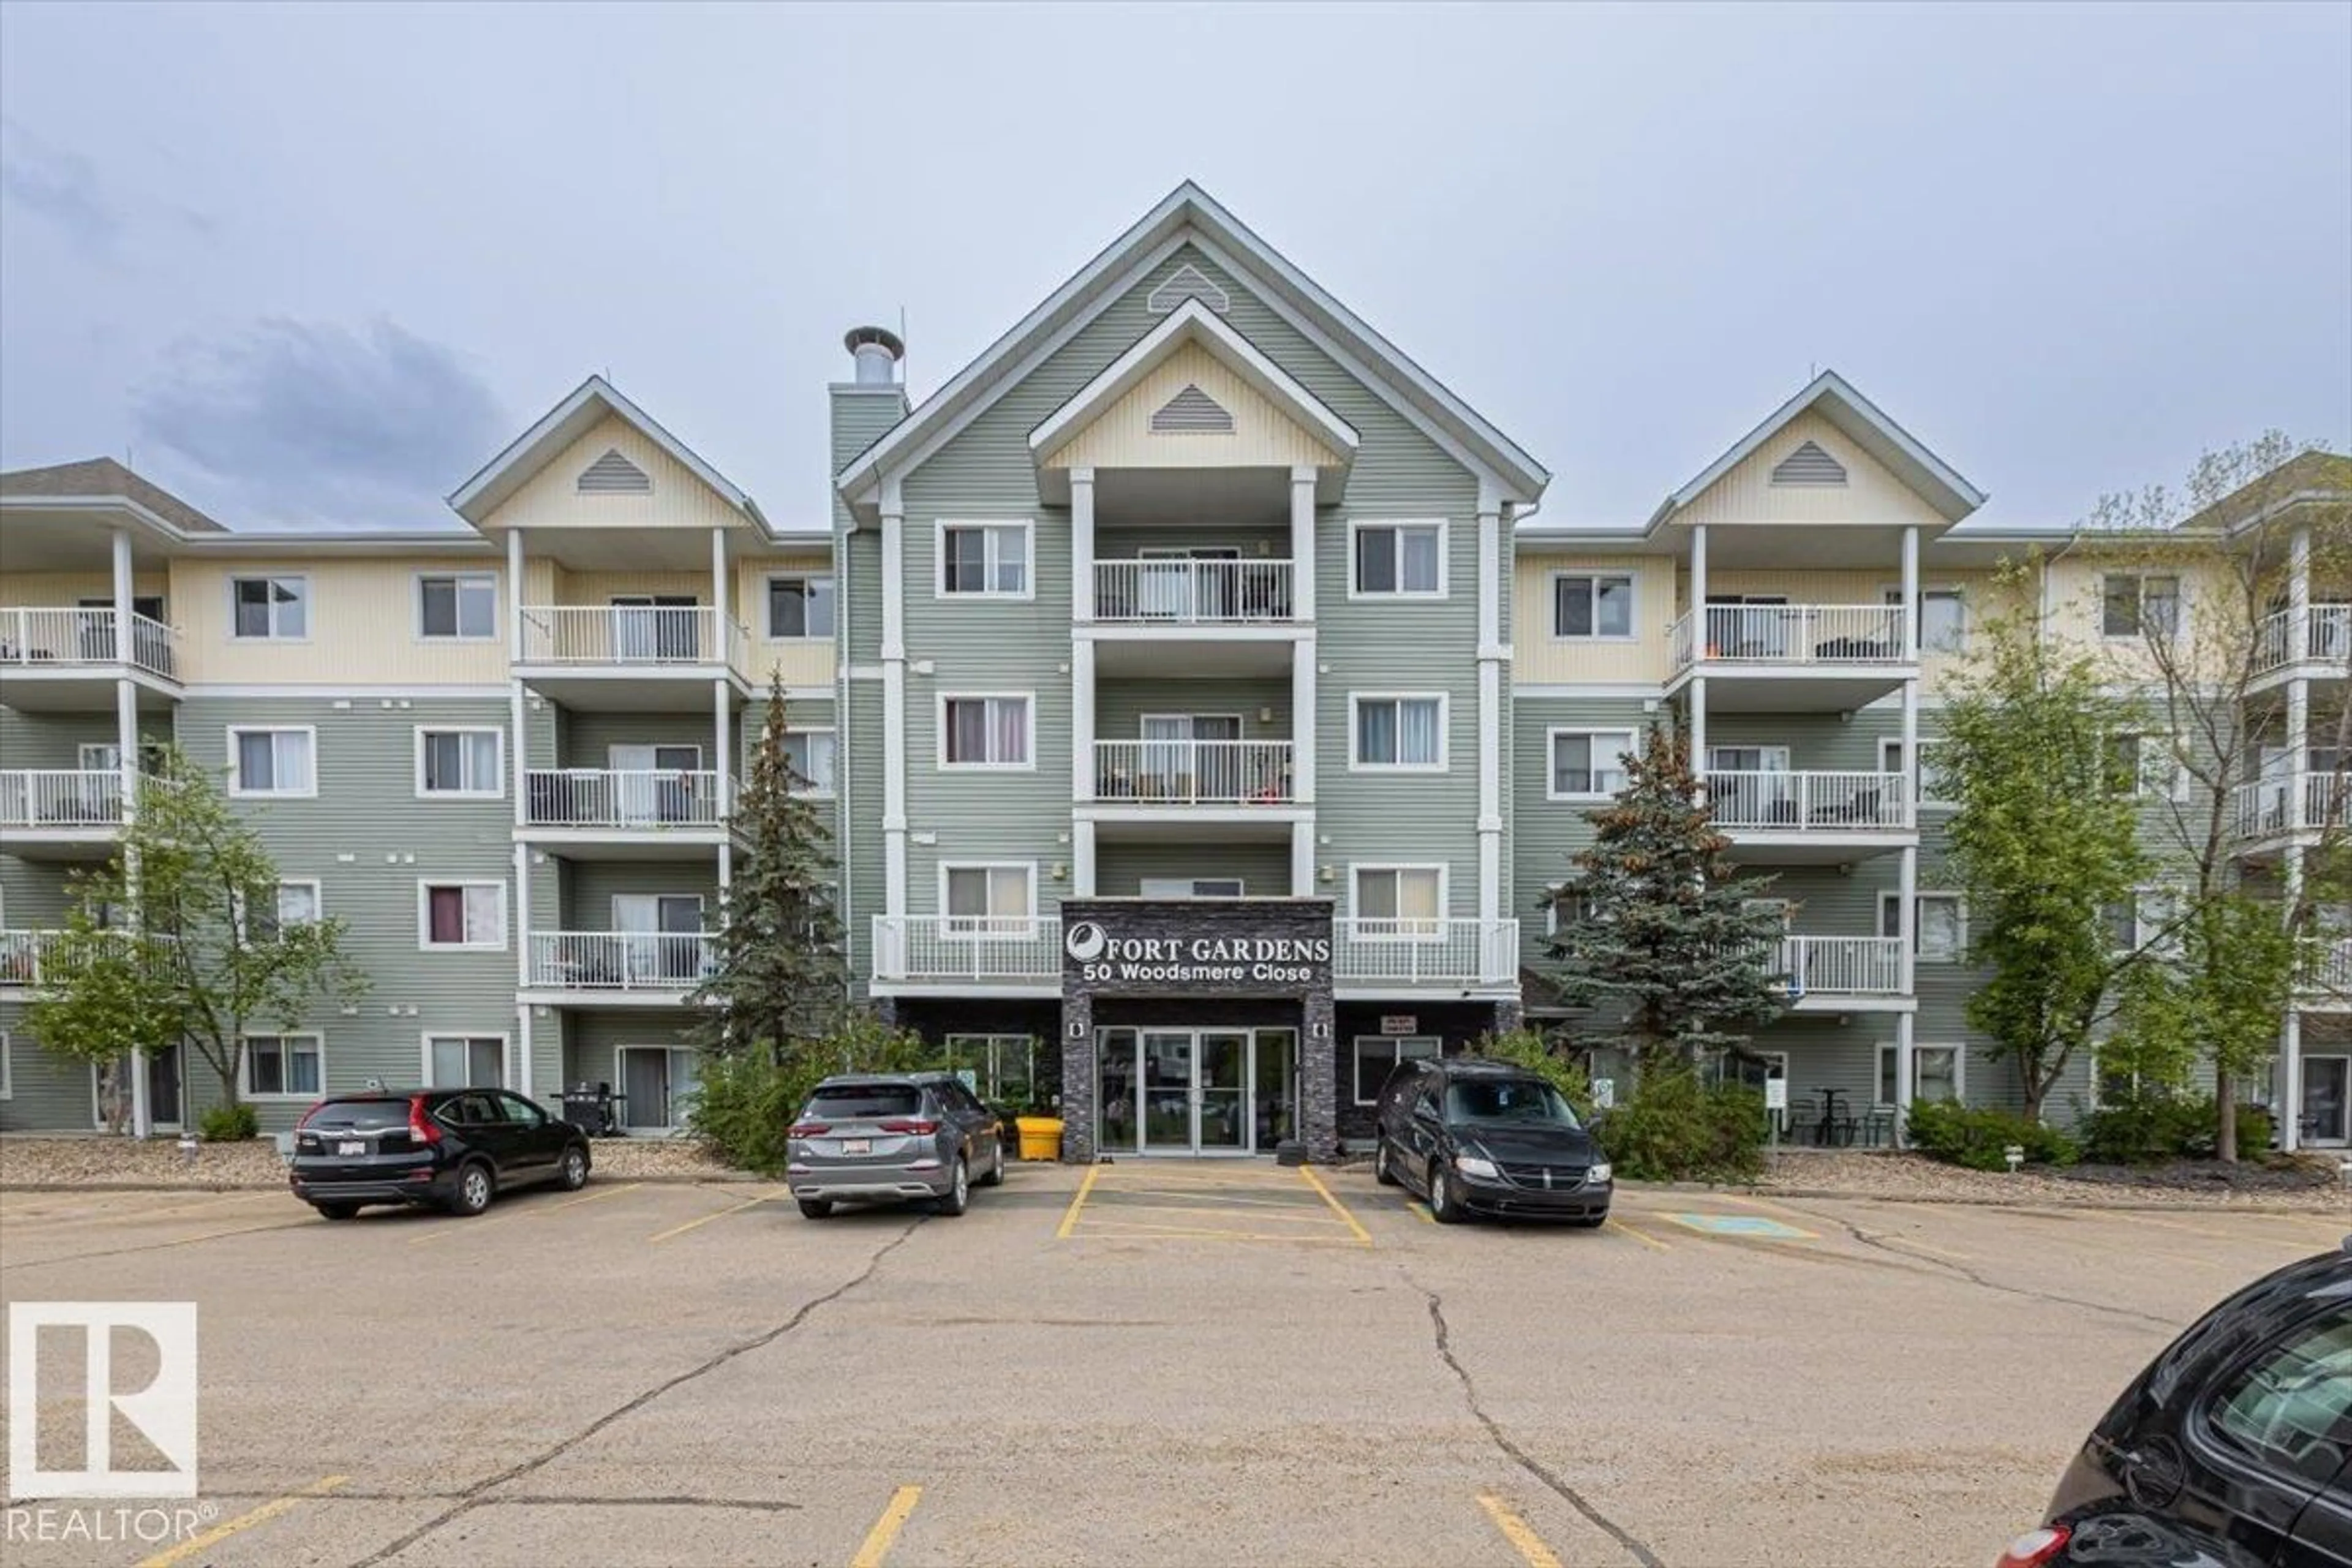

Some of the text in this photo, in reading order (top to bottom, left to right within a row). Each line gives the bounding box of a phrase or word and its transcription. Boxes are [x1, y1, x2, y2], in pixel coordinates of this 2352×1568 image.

[1106, 938, 1330, 962] FORT GARDENS
[1083, 963, 1311, 981] 50 Woodsmere Close
